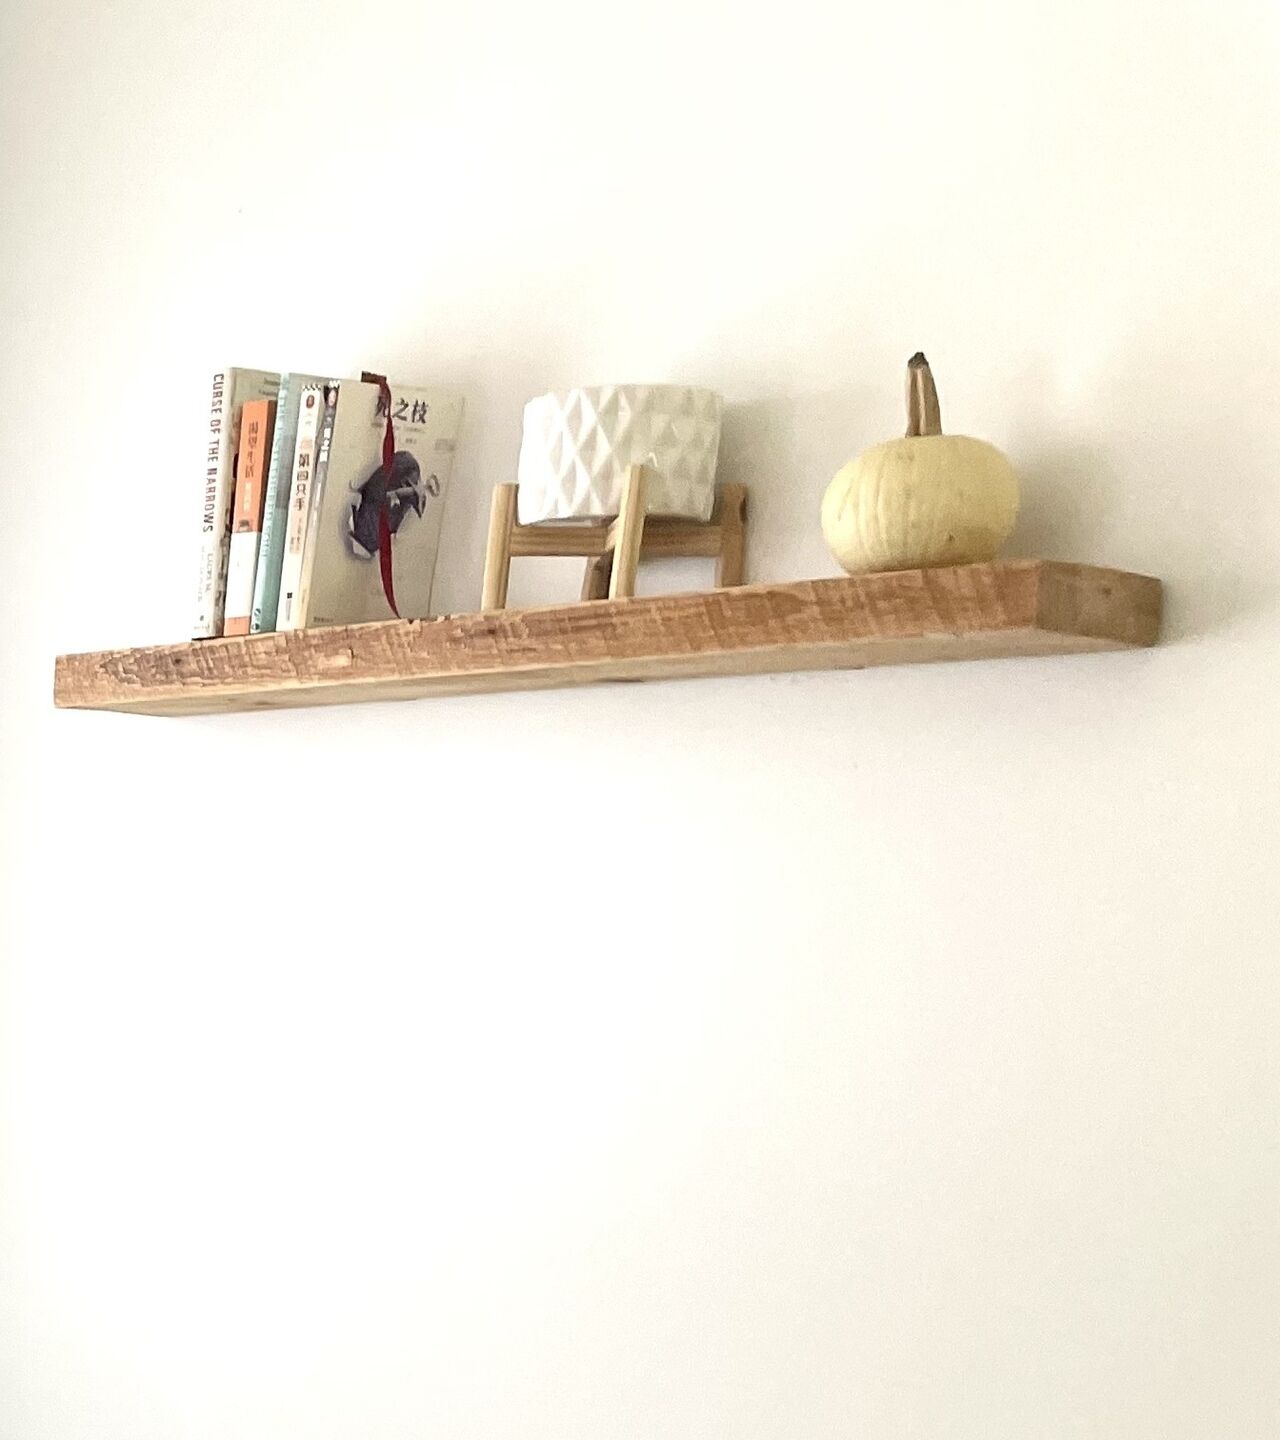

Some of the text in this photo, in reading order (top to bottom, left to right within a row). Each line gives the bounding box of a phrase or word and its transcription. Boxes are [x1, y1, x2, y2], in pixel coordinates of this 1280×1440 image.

[203, 373, 224, 532] CURSE OF THE NARROWS
